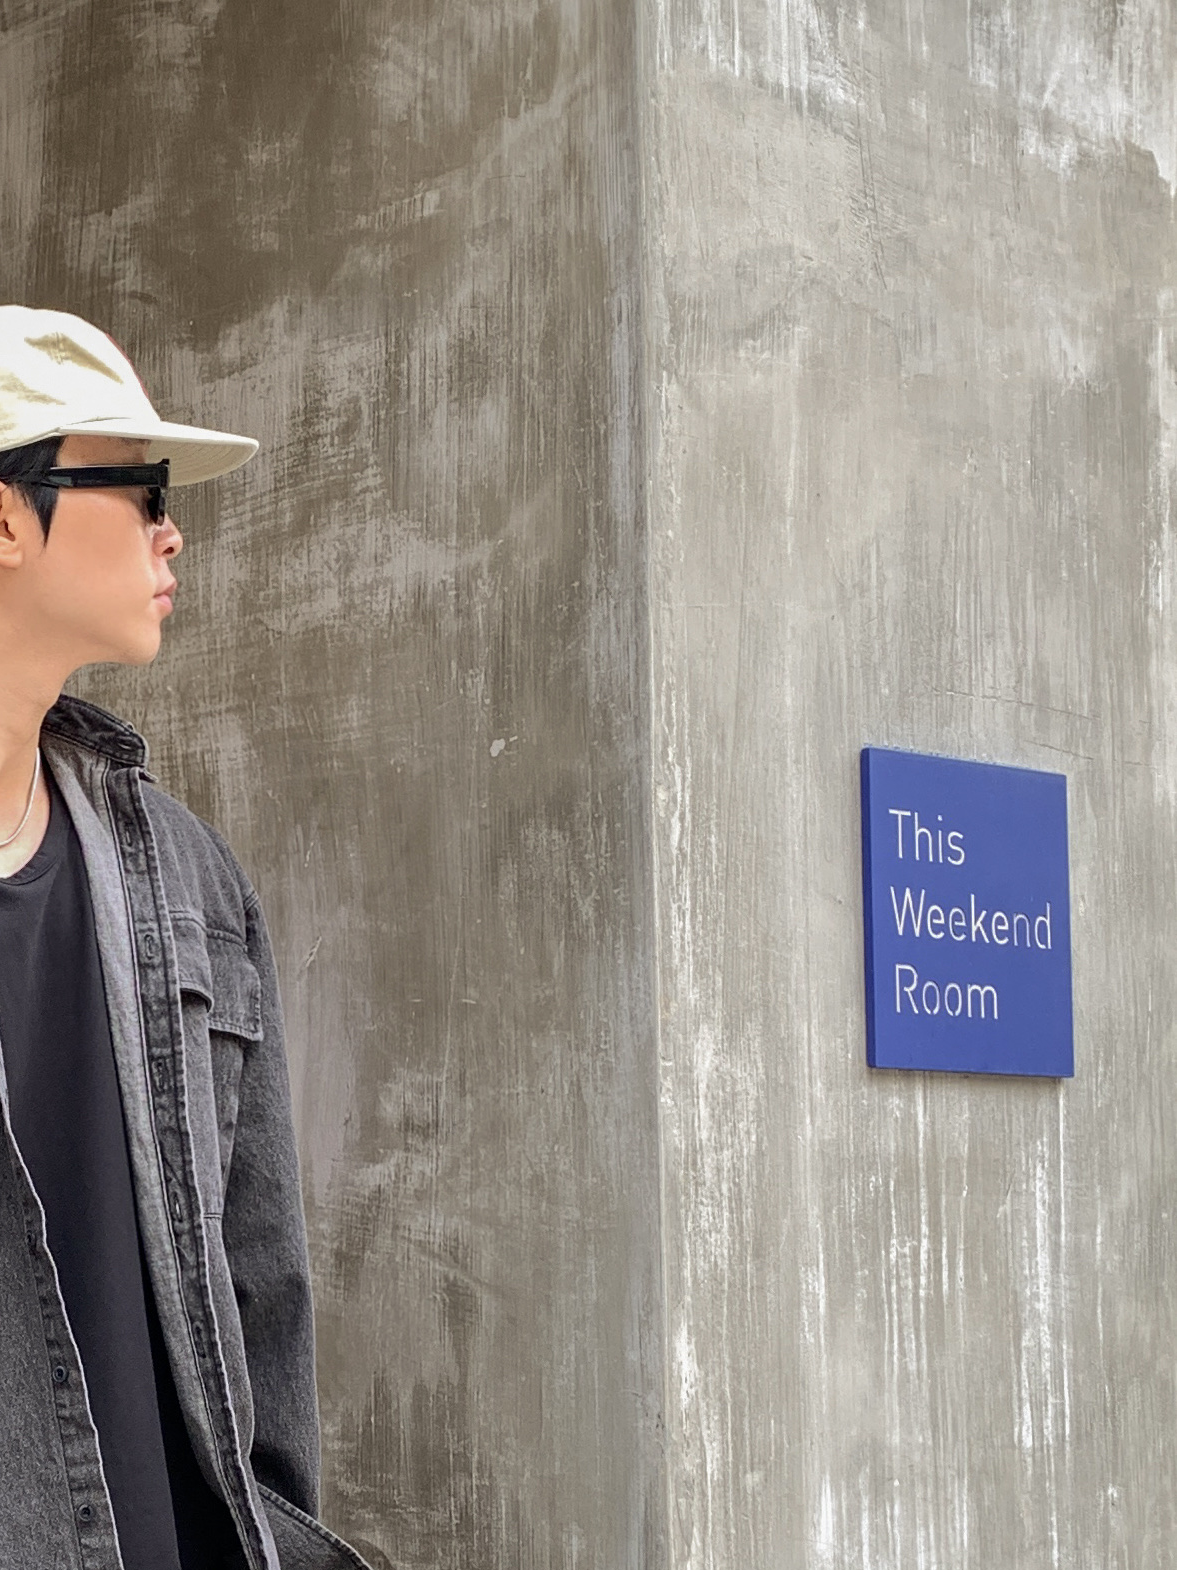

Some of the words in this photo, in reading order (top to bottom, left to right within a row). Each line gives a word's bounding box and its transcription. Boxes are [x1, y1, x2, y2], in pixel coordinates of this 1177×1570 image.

[888, 808, 965, 866] This
[889, 885, 1052, 949] Weekend
[895, 963, 998, 1019] Room
